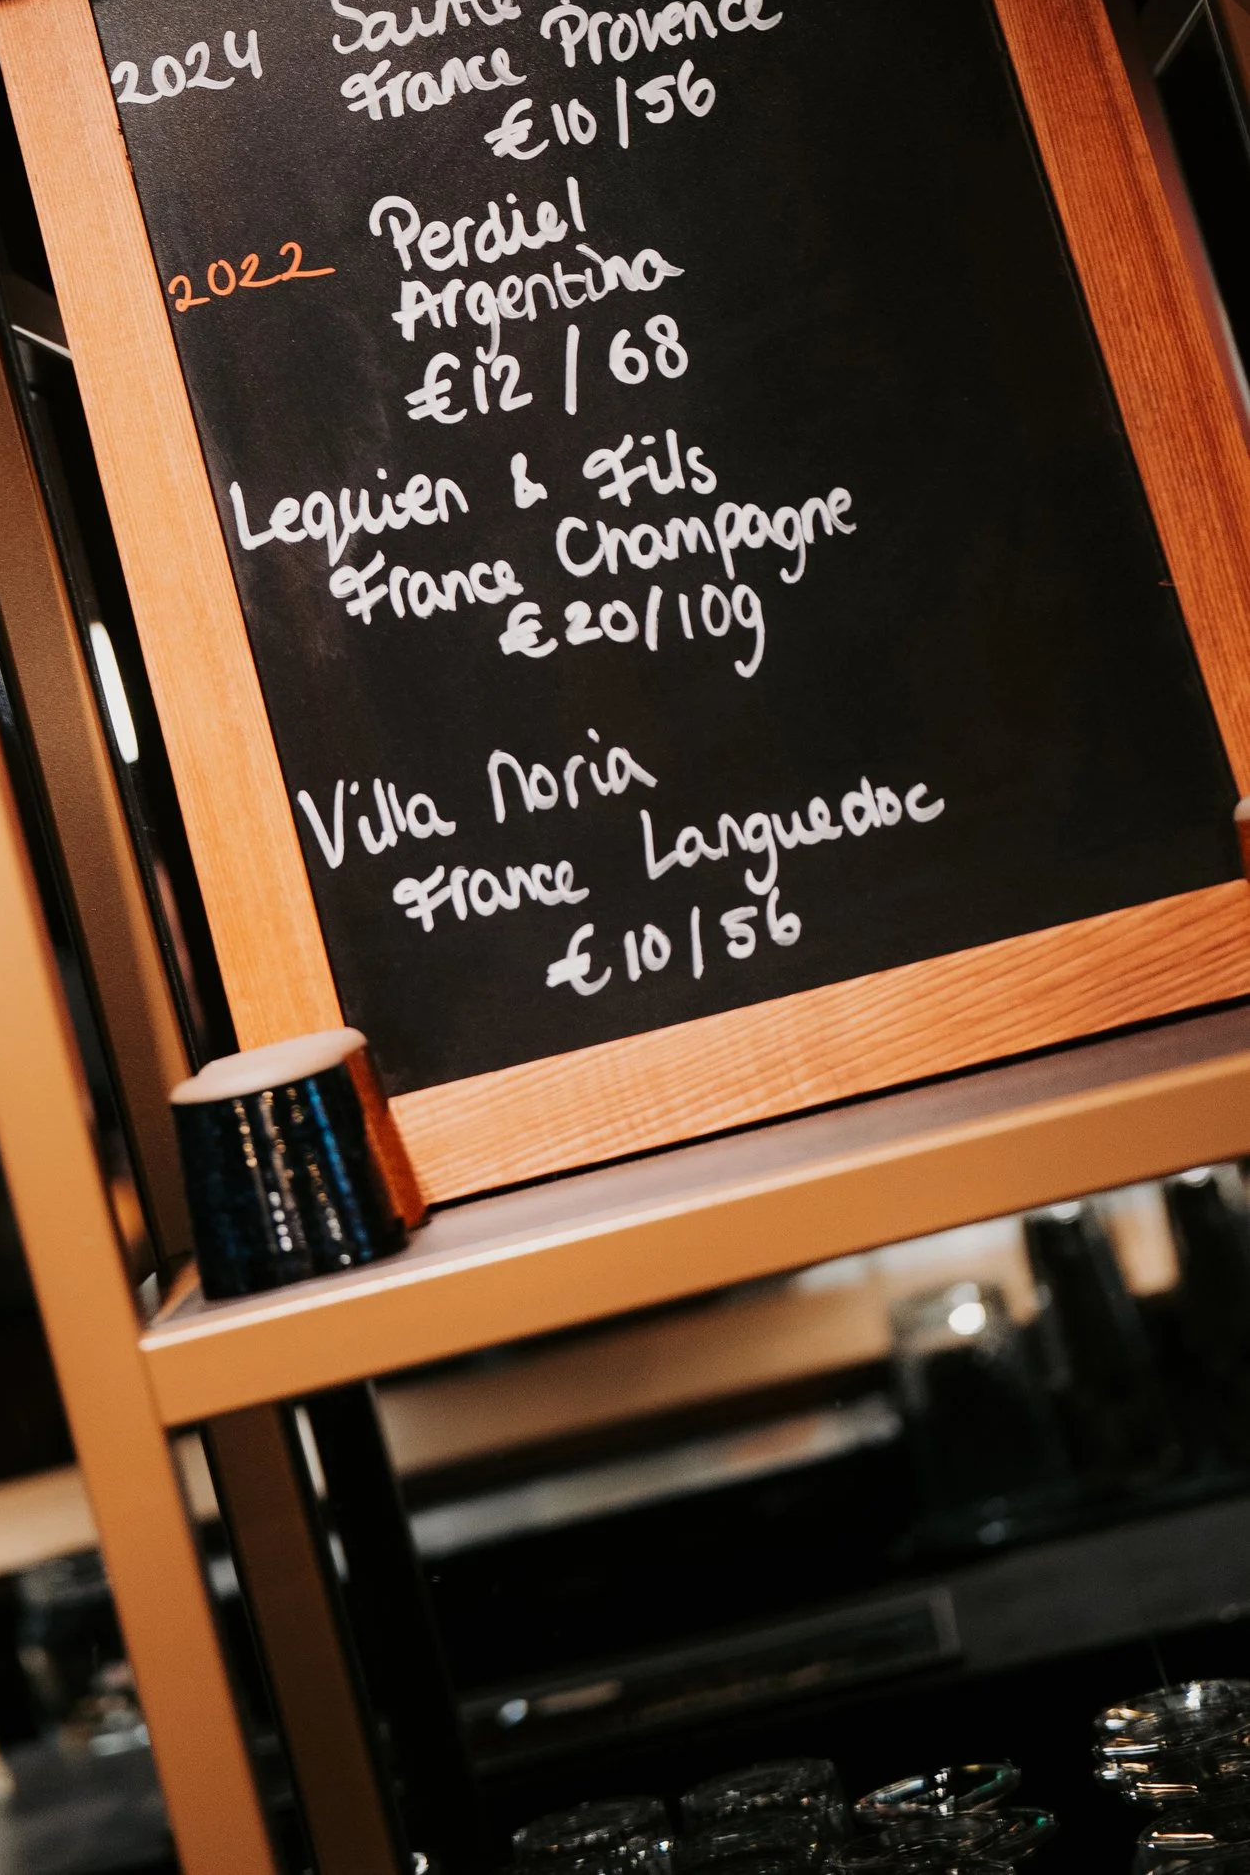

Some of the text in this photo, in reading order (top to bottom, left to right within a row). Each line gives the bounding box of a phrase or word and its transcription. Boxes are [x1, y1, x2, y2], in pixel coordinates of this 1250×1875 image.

[113, 30, 264, 105] 2024
[341, 46, 527, 122] France
[369, 176, 588, 273] Perdiel
[169, 241, 685, 364] 2022 Argentina
[406, 353, 532, 424] €12
[609, 315, 689, 385] 68
[230, 429, 718, 565] Lequien & Fils
[331, 486, 856, 624] France Champagne
[298, 779, 455, 869] Villa
[392, 776, 944, 933] France Languedoc
